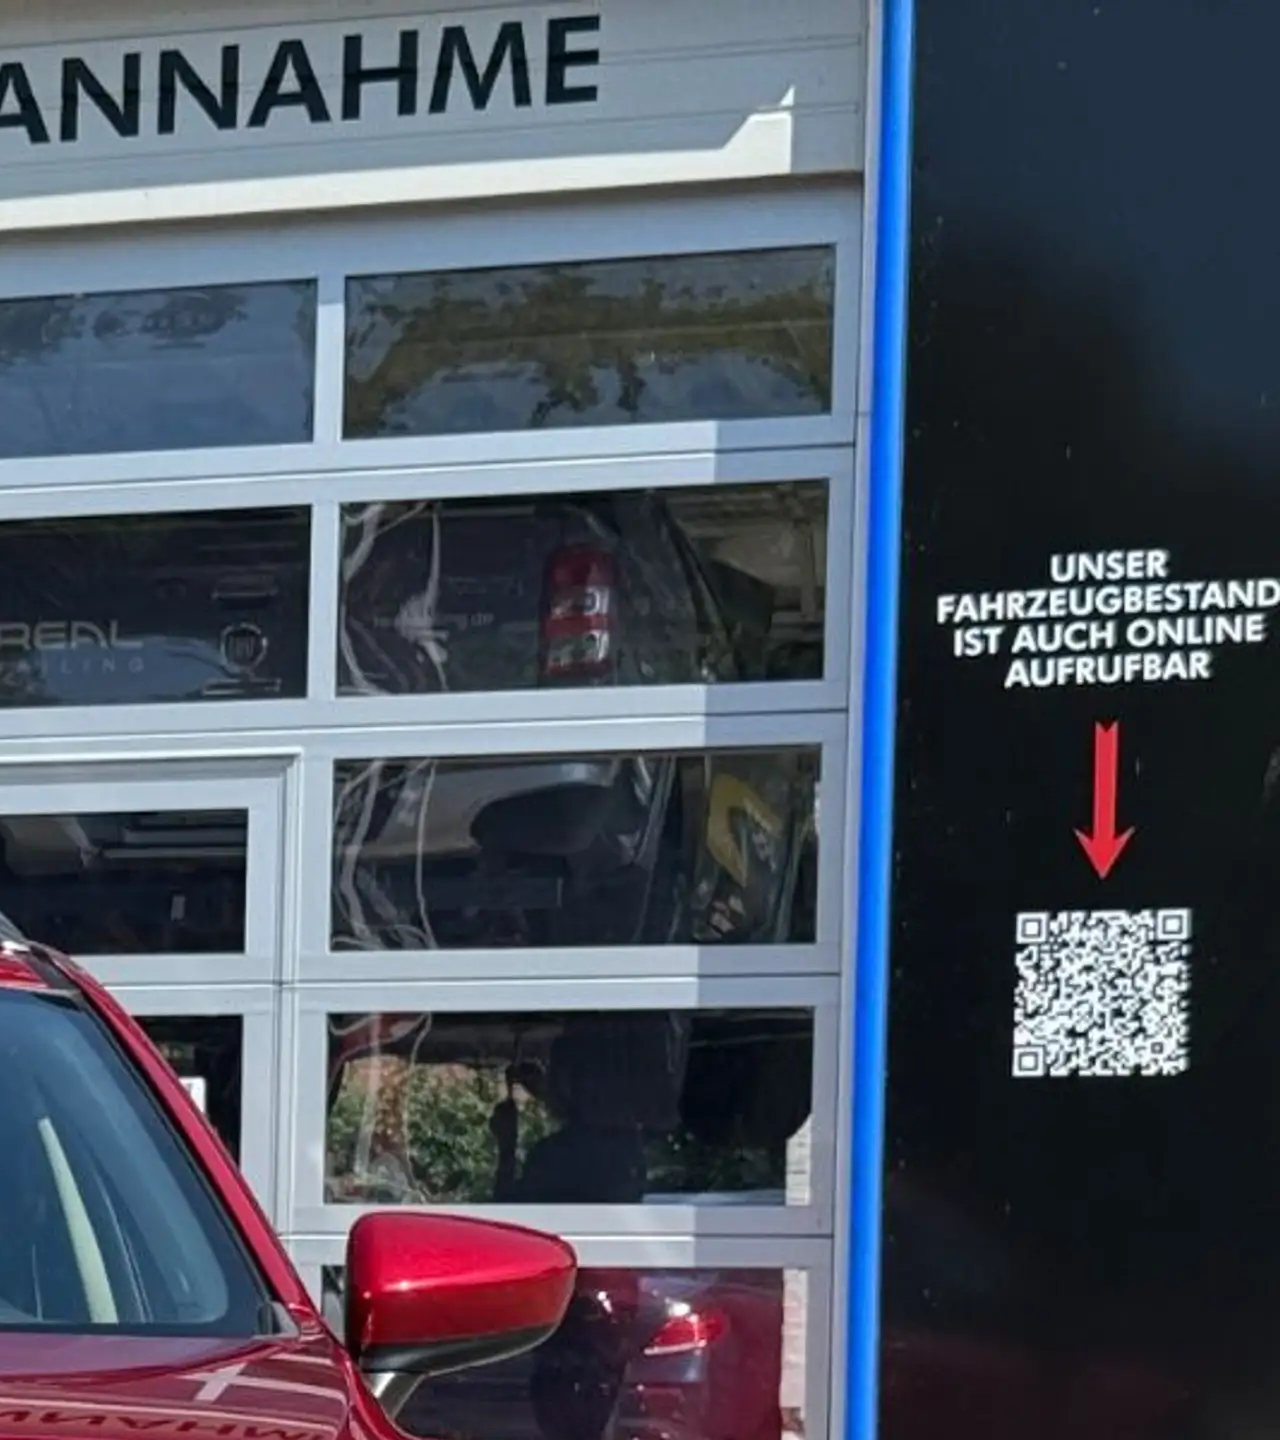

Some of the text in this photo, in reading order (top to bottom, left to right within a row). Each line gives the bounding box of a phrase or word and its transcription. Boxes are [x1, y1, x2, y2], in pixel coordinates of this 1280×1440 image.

[1051, 549, 1168, 583] UNSER
[936, 578, 1280, 624] FAHRZEUGBESTAND
[954, 614, 1266, 657] IST AUCH ONLINE
[1004, 651, 1211, 689] AUFRUFBAR
